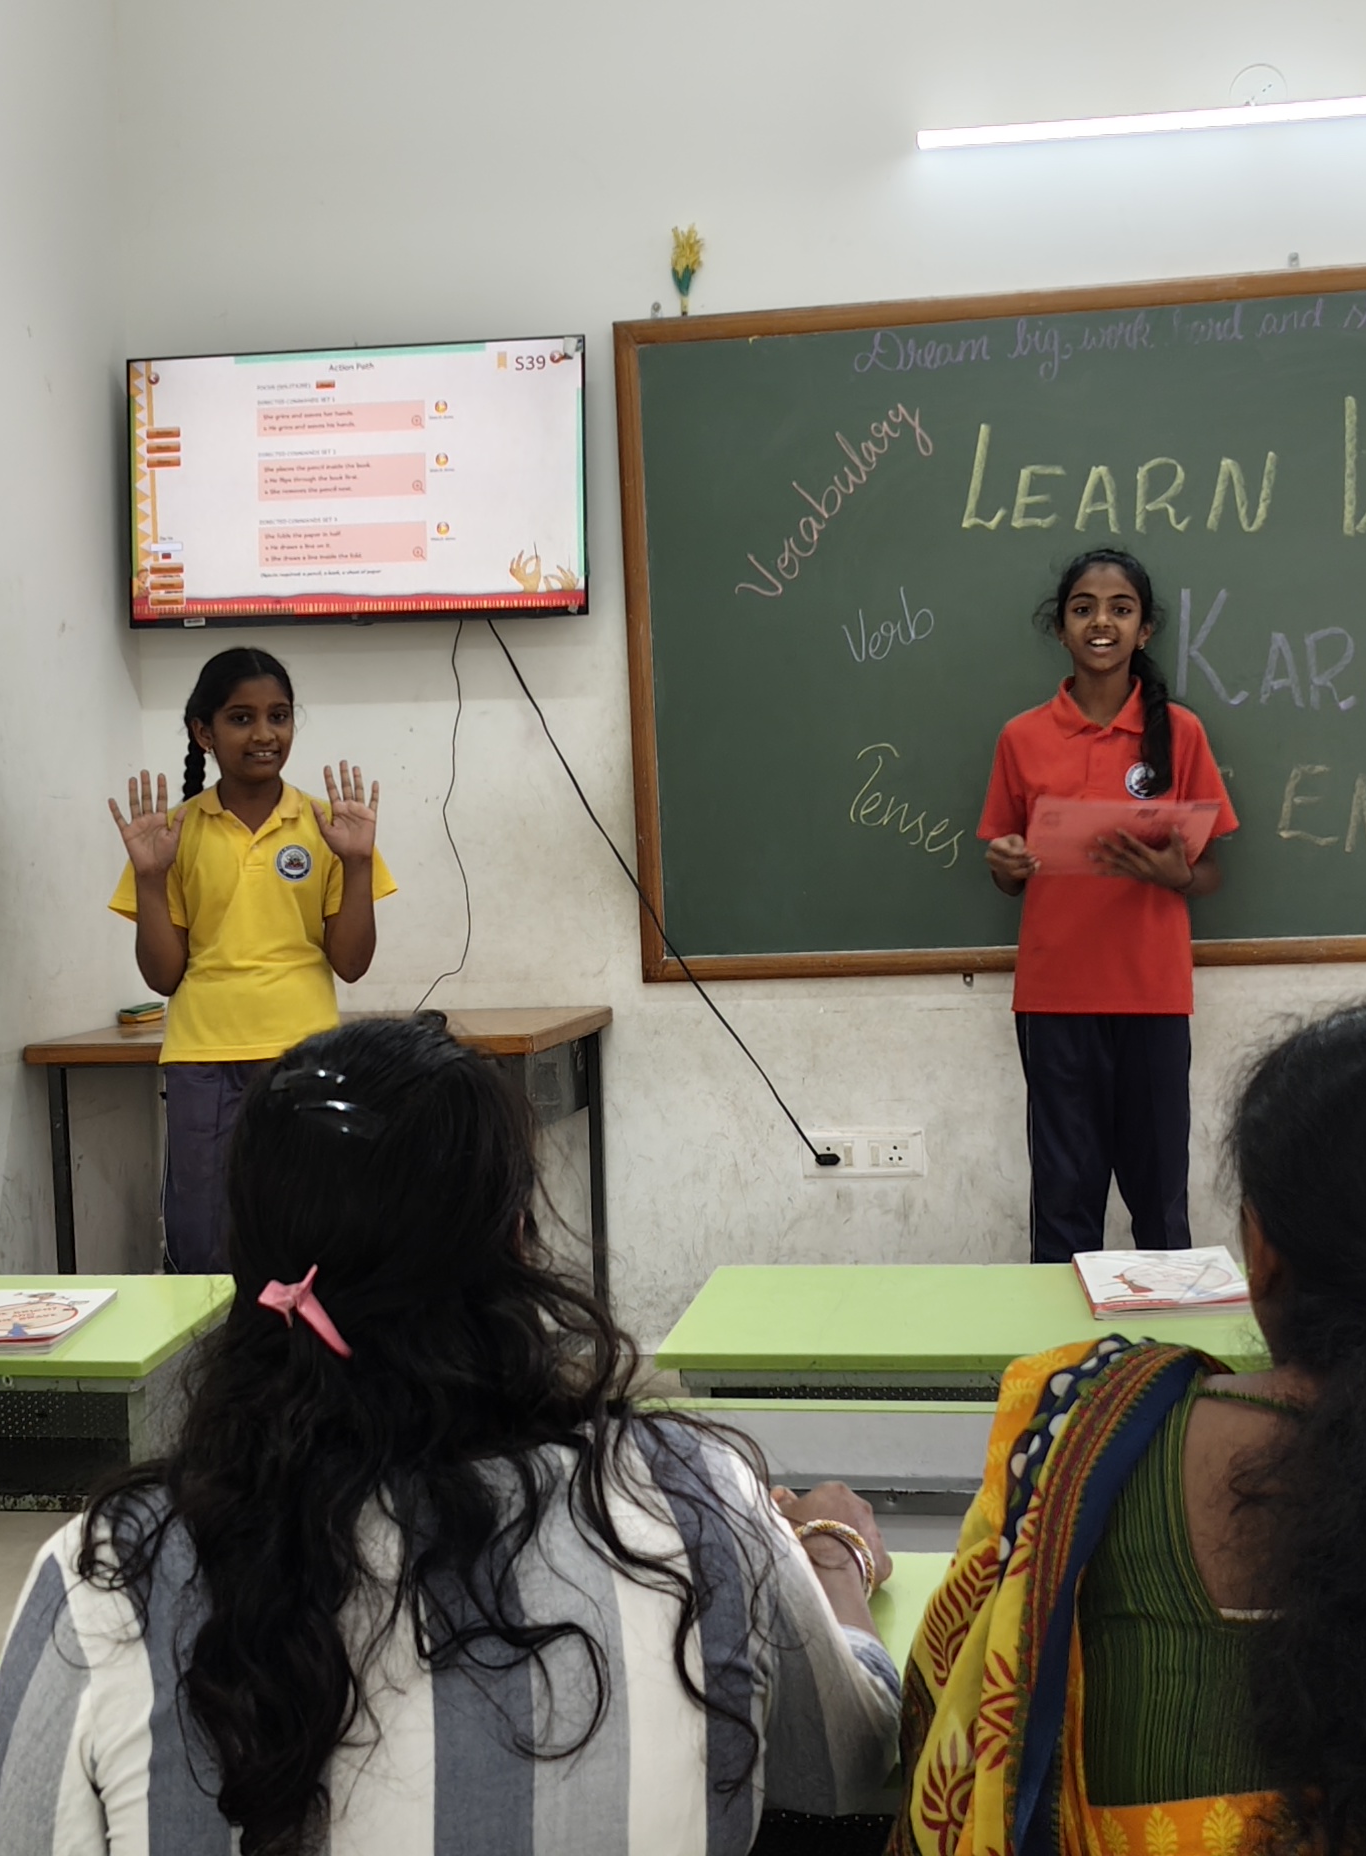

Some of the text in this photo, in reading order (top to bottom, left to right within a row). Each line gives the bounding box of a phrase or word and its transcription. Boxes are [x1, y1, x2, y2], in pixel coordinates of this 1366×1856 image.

[515, 354, 546, 371] S39
[854, 330, 990, 372] Dream
[1079, 310, 1155, 351] work
[1256, 296, 1325, 339] and
[735, 402, 934, 598] Vocabulary
[961, 423, 1278, 535] LEARN
[842, 586, 935, 663] Verb
[849, 742, 966, 869] Tenses
